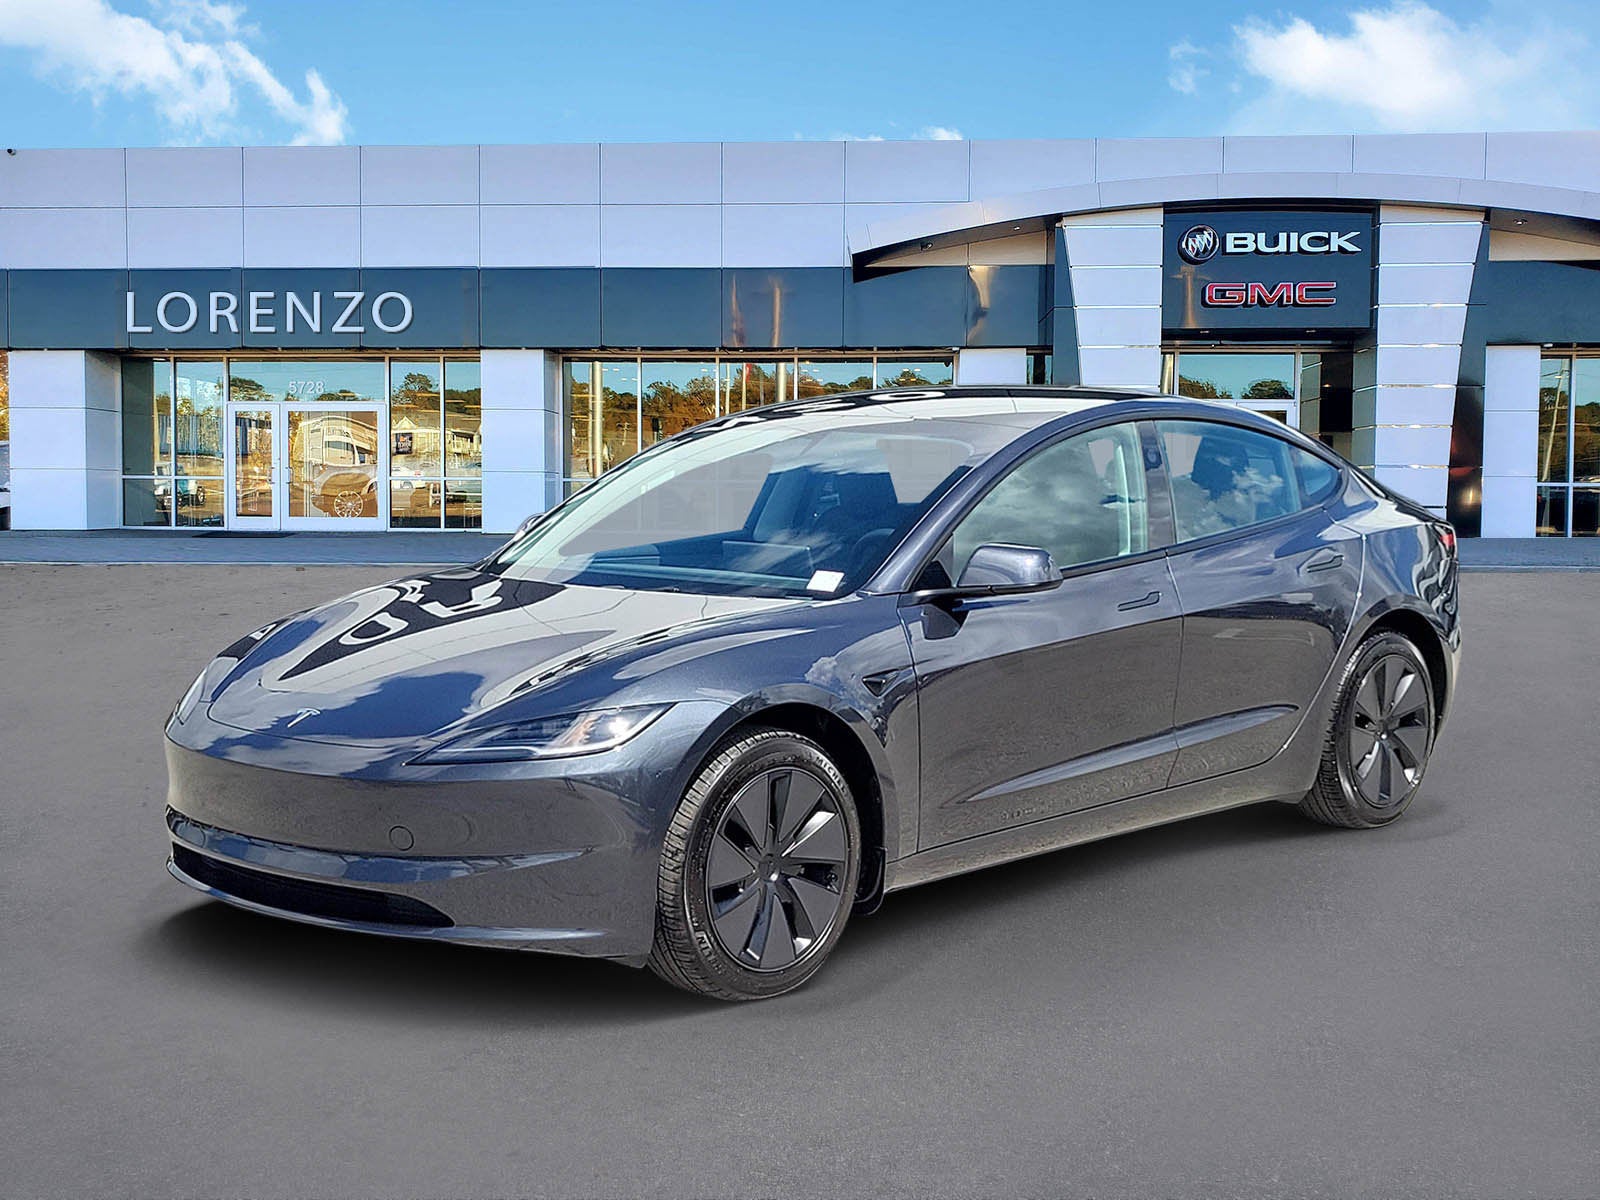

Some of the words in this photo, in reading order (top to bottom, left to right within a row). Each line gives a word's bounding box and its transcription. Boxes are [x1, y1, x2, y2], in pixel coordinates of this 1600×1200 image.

[1226, 231, 1361, 253] BUICK
[1205, 281, 1337, 305] GMC
[126, 291, 413, 334] LORENZO
[288, 381, 325, 394] 5728
